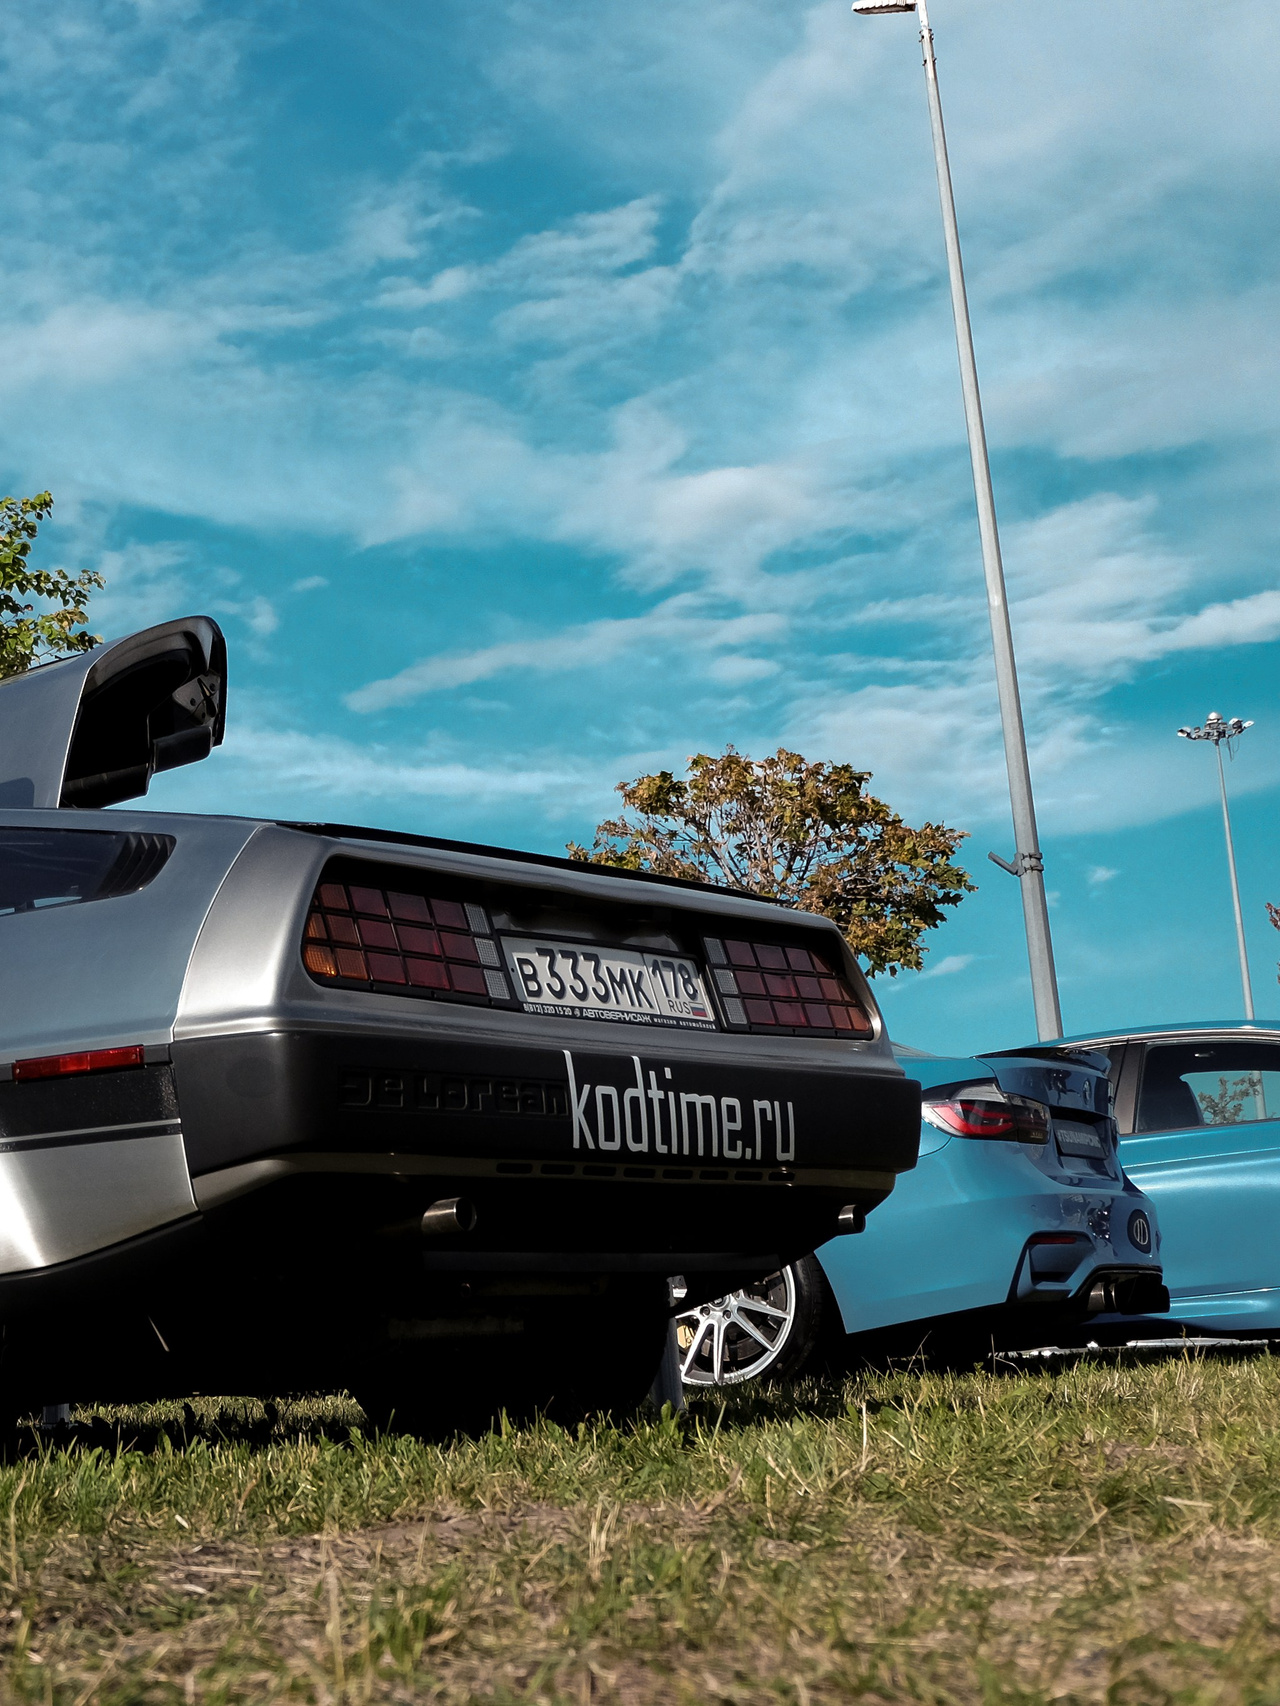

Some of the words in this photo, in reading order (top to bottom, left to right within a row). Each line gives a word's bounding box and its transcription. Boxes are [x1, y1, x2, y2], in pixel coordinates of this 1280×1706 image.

[652, 959, 698, 1001] 178
[543, 1006, 555, 1014] 320
[582, 1009, 652, 1023] АВТОВЕРНИСАЖ
[669, 999, 692, 1015] RUS
[563, 1050, 796, 1161] kodtime.ru
